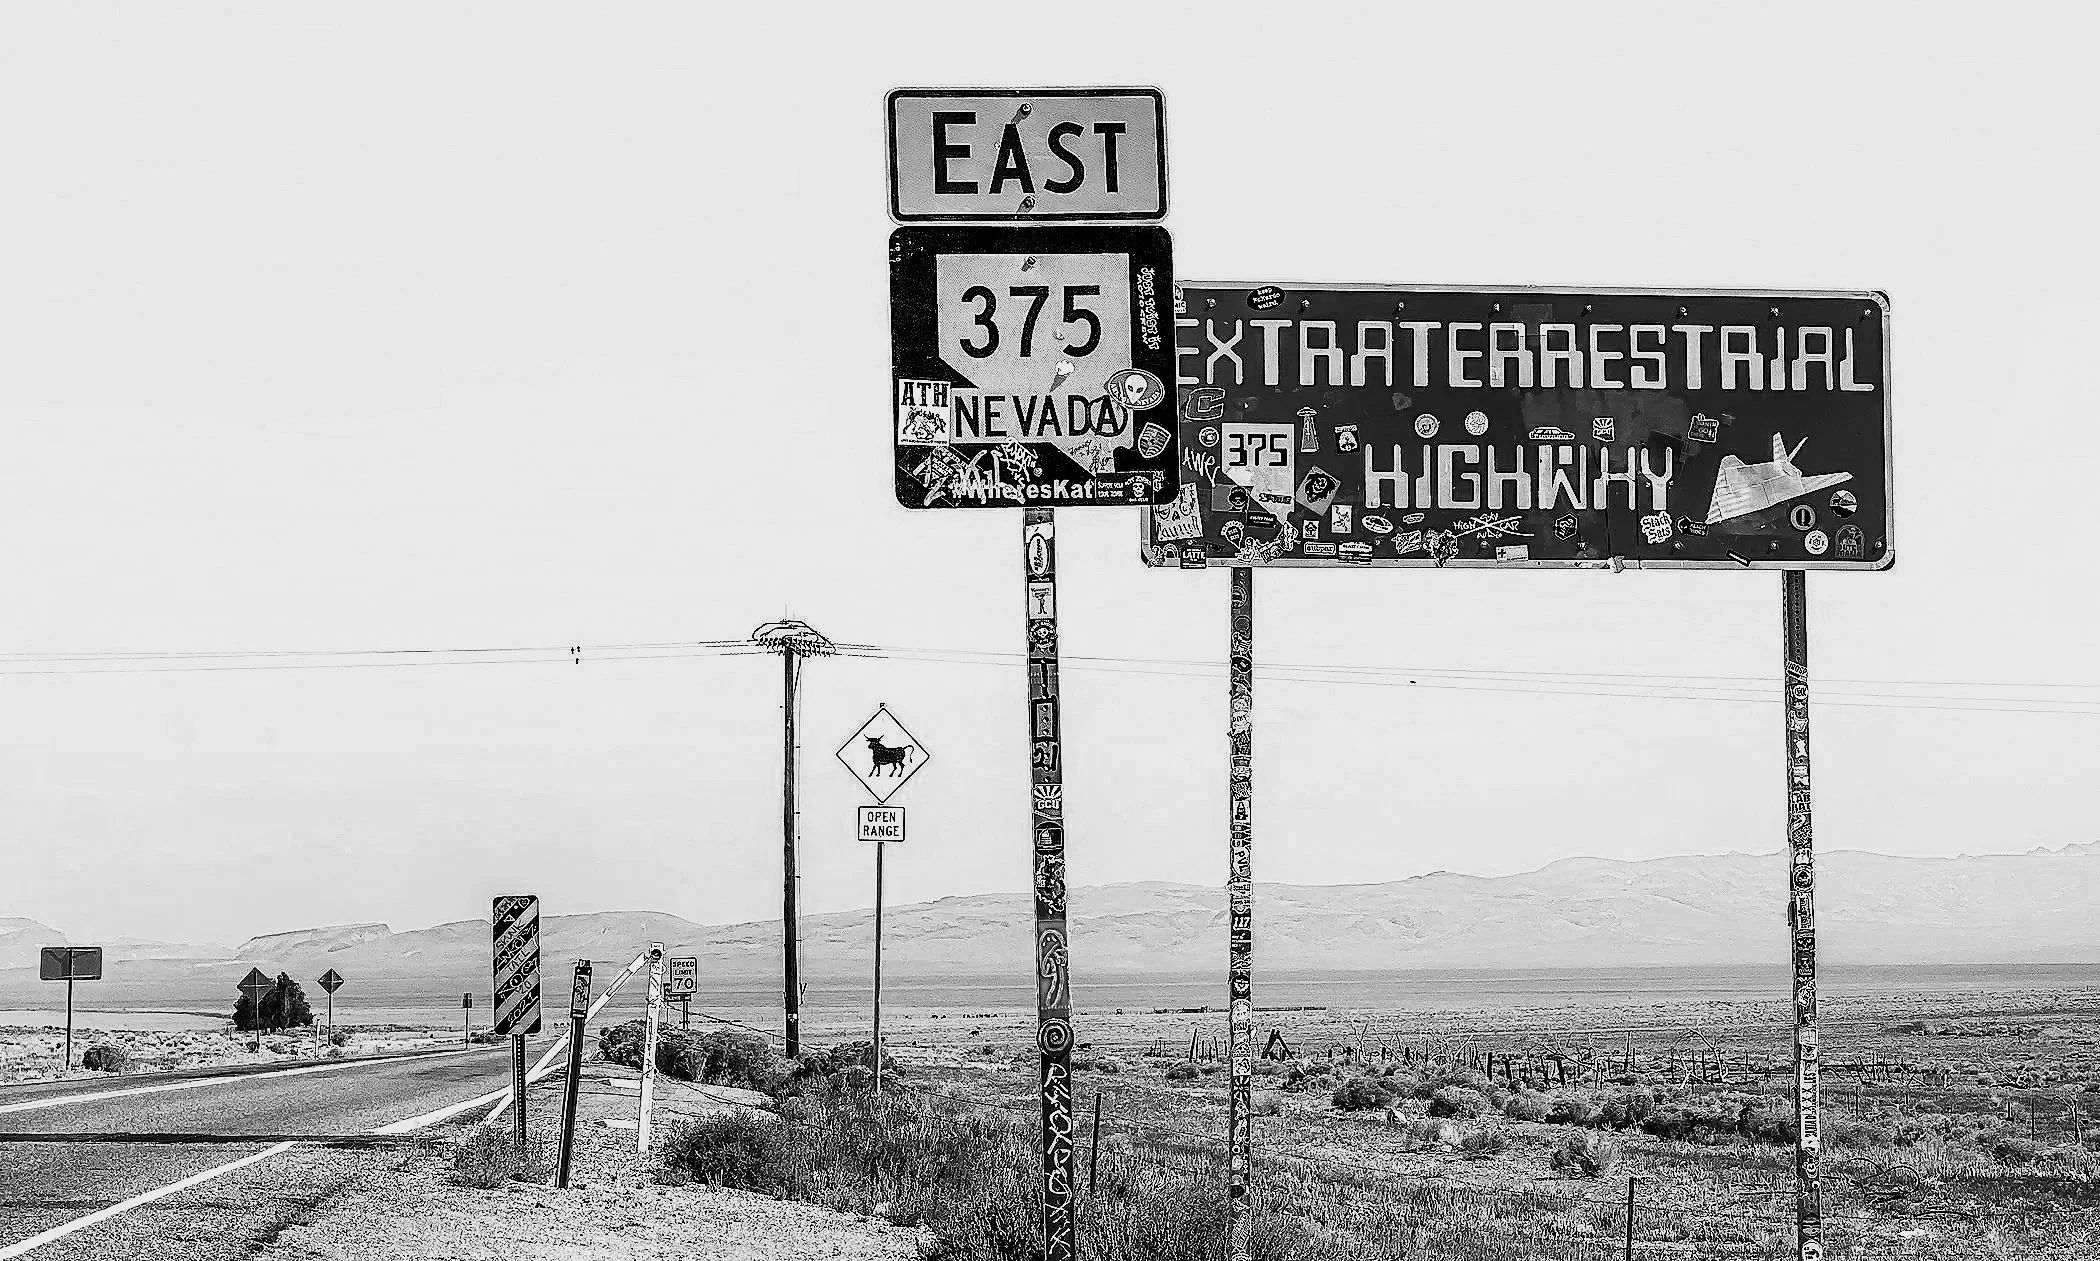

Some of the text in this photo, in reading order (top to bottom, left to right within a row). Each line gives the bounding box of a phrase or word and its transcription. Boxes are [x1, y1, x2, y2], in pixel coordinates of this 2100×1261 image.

[932, 111, 1127, 194] EAST
[959, 286, 1102, 359] 375
[1175, 318, 1876, 392] EXTRATERRESTRIAL
[901, 381, 949, 407] ATH
[954, 394, 1120, 438] NEVADA
[1229, 434, 1289, 467] 375
[863, 825, 900, 837] RANGE
[867, 811, 896, 823] OPEN
[673, 977, 694, 990] 70
